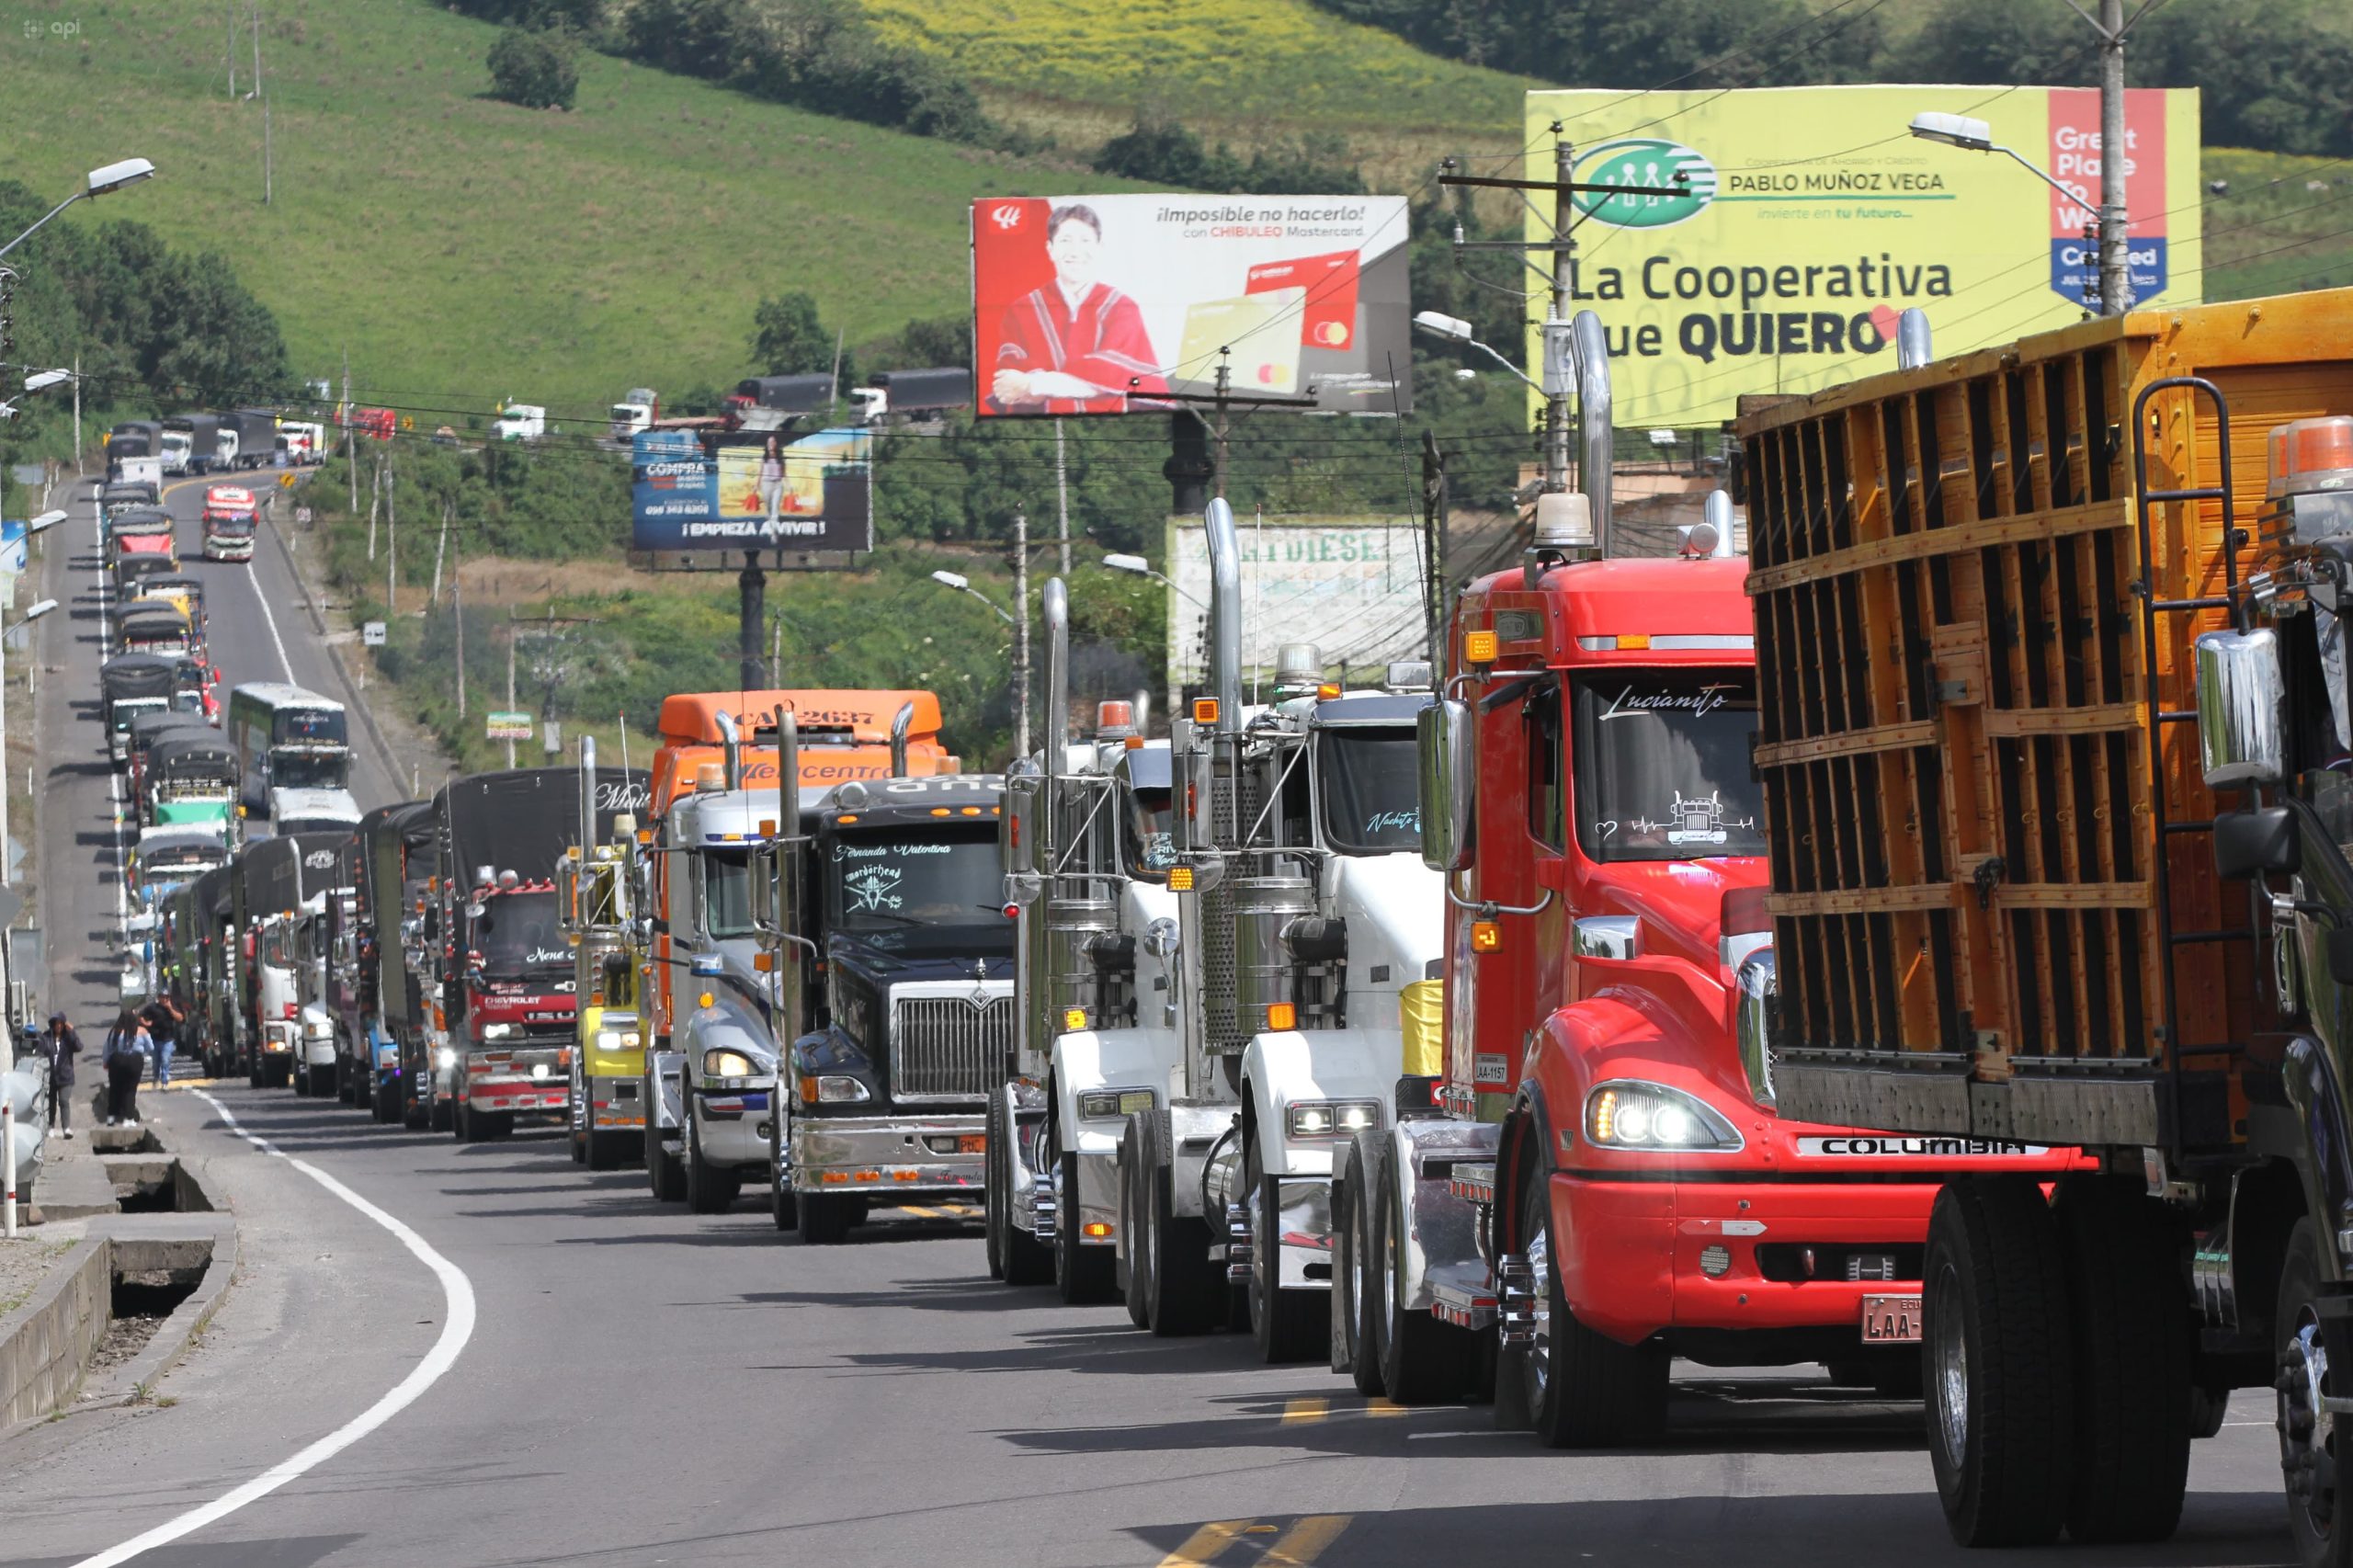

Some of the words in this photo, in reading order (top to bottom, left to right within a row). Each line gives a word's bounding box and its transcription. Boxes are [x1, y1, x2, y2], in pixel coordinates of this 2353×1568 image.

[2055, 127, 2138, 151] Gret
[2058, 153, 2137, 177] Plae
[1730, 174, 1799, 192] PABLO
[1805, 169, 1882, 191] MUÑOZ
[1888, 173, 1946, 190] VEGA
[1156, 206, 1255, 225] ¡Imposible
[1258, 209, 1283, 222] no
[1287, 205, 1367, 222] hacerlo!
[1814, 210, 1832, 219] en
[1836, 208, 1852, 219] tu
[1183, 228, 1207, 238] con
[1210, 225, 1284, 238] CHIBULEO
[1571, 257, 1624, 301] La
[1643, 253, 1953, 311] Cooperativa
[1605, 324, 1662, 358] ue
[1678, 312, 1886, 365] QUIERO
[690, 522, 756, 537] EMPIEZA
[777, 521, 817, 536] VIVIR
[1598, 681, 1742, 721] Lucianito
[733, 710, 875, 726] CA-2637
[832, 845, 887, 862] Fernanda
[893, 844, 951, 857] Valentina
[484, 996, 540, 1005] CHEVROLET
[529, 1011, 575, 1020] ISU
[1476, 1066, 1506, 1080] LAA-1157
[1901, 1300, 1922, 1310] ECU
[1867, 1312, 1921, 1339] LAA-
